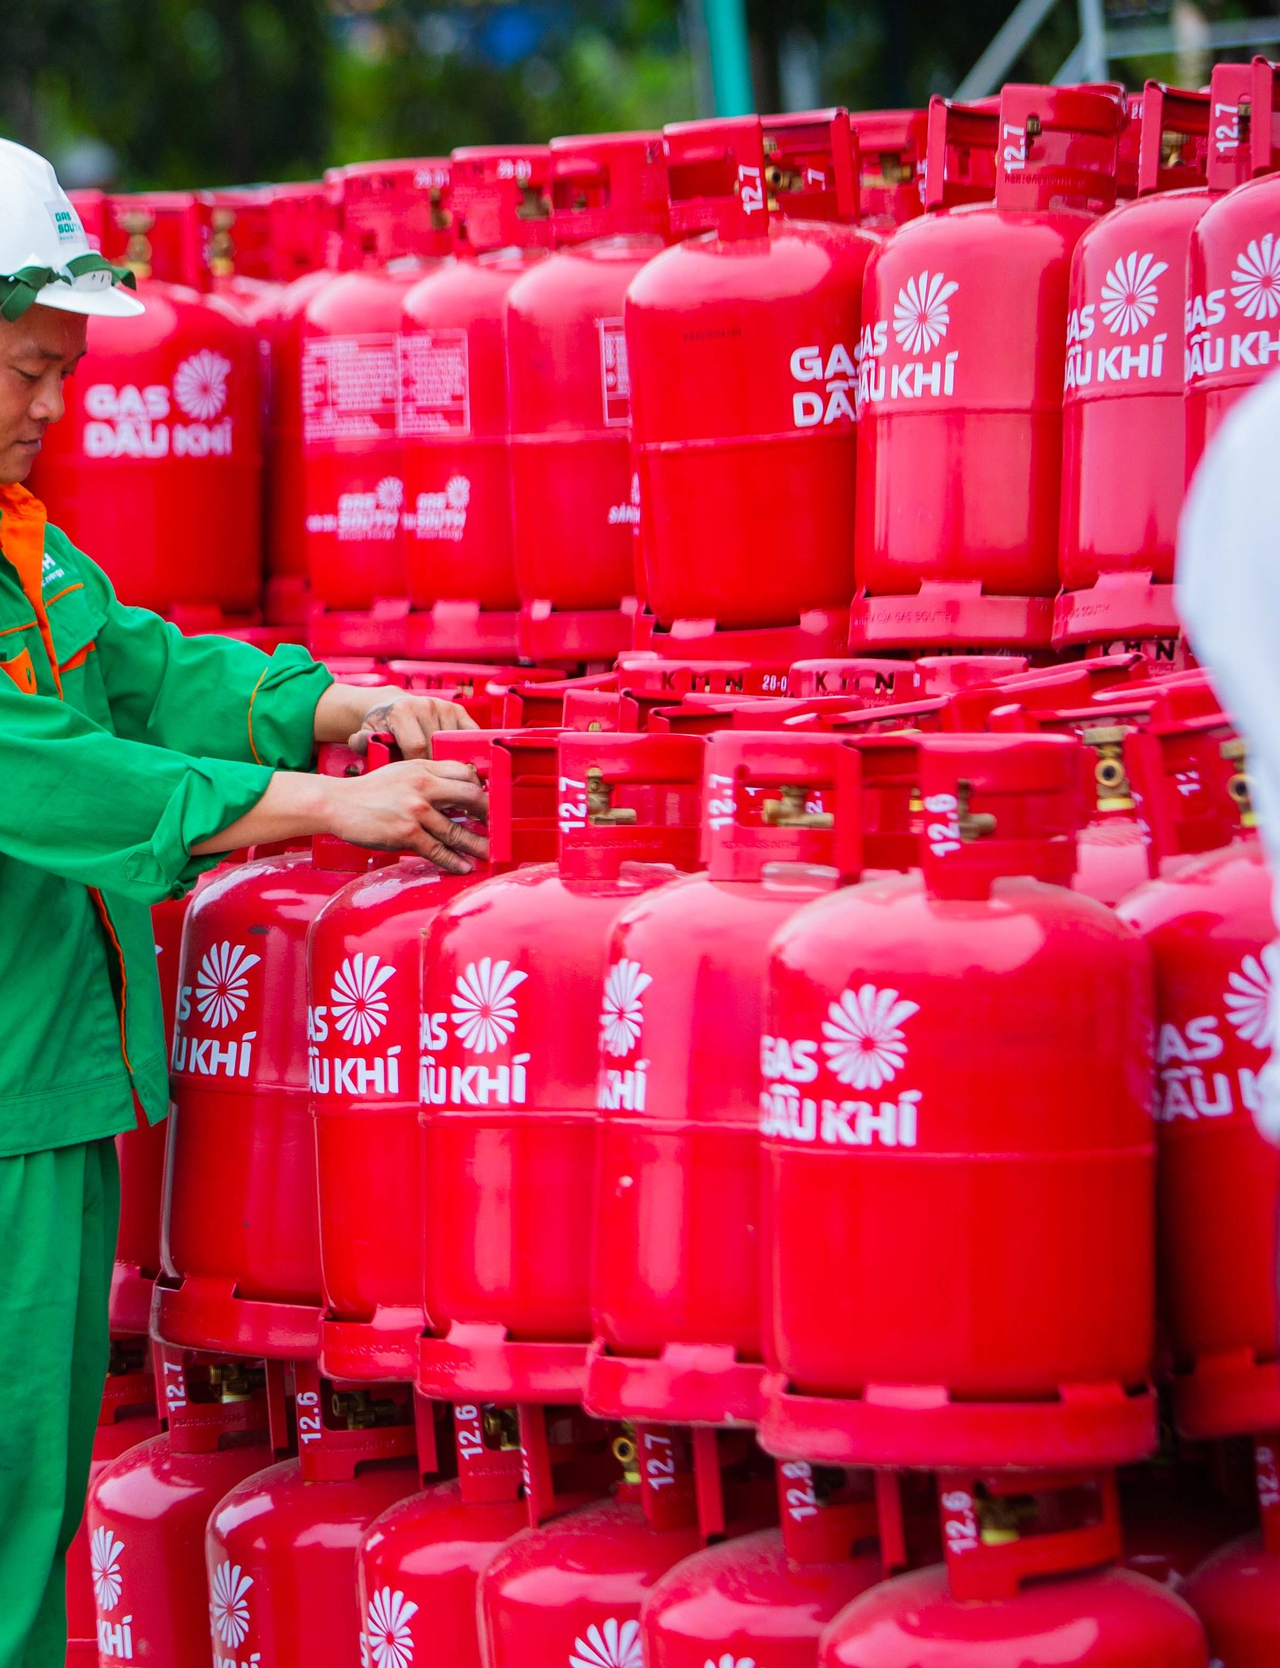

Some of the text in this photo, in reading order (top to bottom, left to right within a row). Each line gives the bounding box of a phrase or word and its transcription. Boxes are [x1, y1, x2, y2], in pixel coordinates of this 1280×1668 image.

[1003, 123, 1026, 174] 12.7
[1215, 102, 1239, 153] 12.7
[738, 164, 765, 216] 12.7
[860, 320, 888, 361] AS
[1064, 332, 1168, 391] ẦU KHÍ
[1230, 330, 1280, 369] KH
[83, 383, 171, 420] GAS
[859, 351, 959, 405] ẦU KHÍ
[171, 416, 233, 458] KHÍ
[559, 776, 587, 833] 12.7
[708, 773, 737, 831] 12.7
[923, 793, 961, 857] 12.6
[308, 1005, 329, 1042] AS
[420, 1012, 448, 1050] AS
[1154, 1015, 1224, 1065] AS
[189, 1030, 257, 1078] KHÍ
[334, 1045, 402, 1094] KHÍ
[420, 1053, 531, 1105] ẦU KHÍ
[821, 1089, 923, 1148] KHÍ
[163, 1361, 188, 1412] 12.7
[297, 1391, 322, 1445] 12.6
[455, 1404, 484, 1461] 12.6
[644, 1433, 675, 1491] 12.7
[781, 1460, 818, 1523] 12.8
[941, 1490, 978, 1556] 12.6
[97, 1614, 133, 1660] KHÍ
